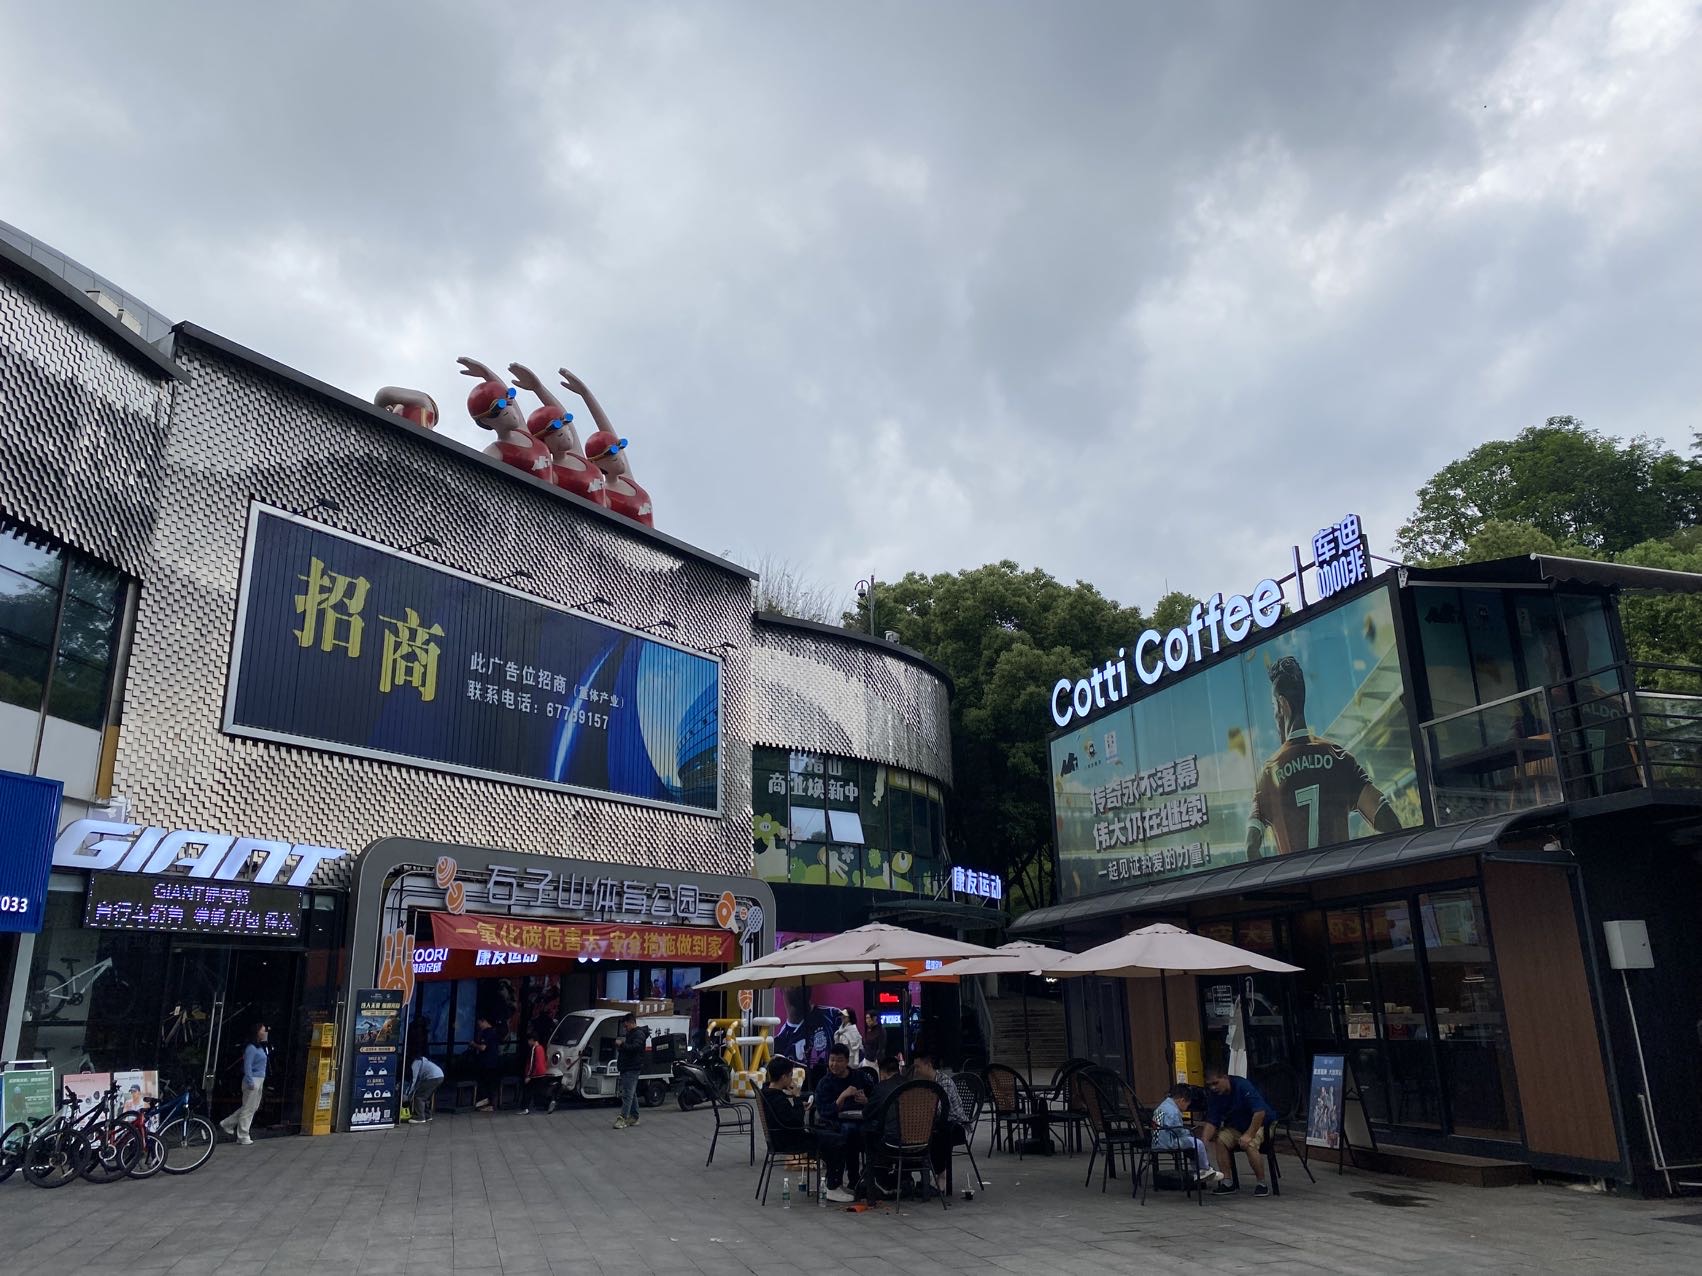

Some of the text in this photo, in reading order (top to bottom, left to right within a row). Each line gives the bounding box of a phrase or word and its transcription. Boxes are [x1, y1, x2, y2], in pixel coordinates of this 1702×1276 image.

[1312, 513, 1361, 566] 库迪
[1316, 546, 1368, 599] 咖啡
[293, 557, 446, 701] 招商
[1051, 579, 1284, 727] Cotti Coffee
[768, 772, 859, 802] 商业焕新中
[1090, 754, 1199, 816] 传奇永不落幕
[1276, 754, 1334, 782] RONALDO
[1093, 793, 1208, 852] 伟大仍在继续！
[1295, 784, 1320, 849] 7
[52, 819, 346, 886] GIANT
[1098, 842, 1211, 882] 一起见证热爱的力量！
[486, 864, 700, 917] 石子山体育公园
[953, 865, 1002, 900] 康友运动
[455, 921, 723, 957] 一氧化碳危害大 安全措施做到家
